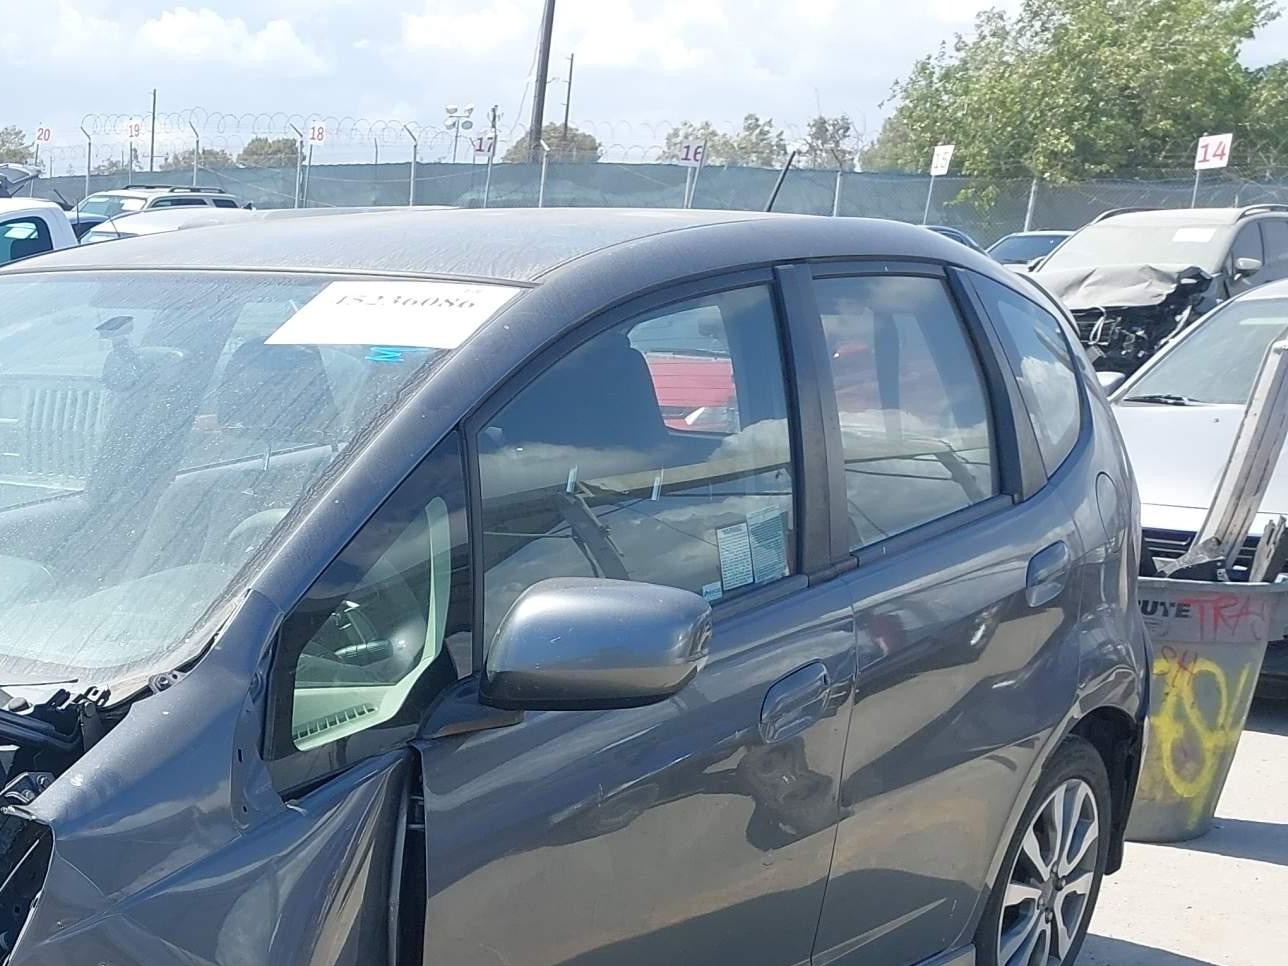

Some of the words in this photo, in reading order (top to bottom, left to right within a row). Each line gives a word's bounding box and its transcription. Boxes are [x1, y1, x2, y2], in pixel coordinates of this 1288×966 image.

[36, 128, 51, 141] 20
[128, 124, 141, 138] 19
[310, 127, 324, 141] 18
[475, 137, 494, 153] 17
[1199, 139, 1227, 164] 14
[681, 145, 702, 162] 16
